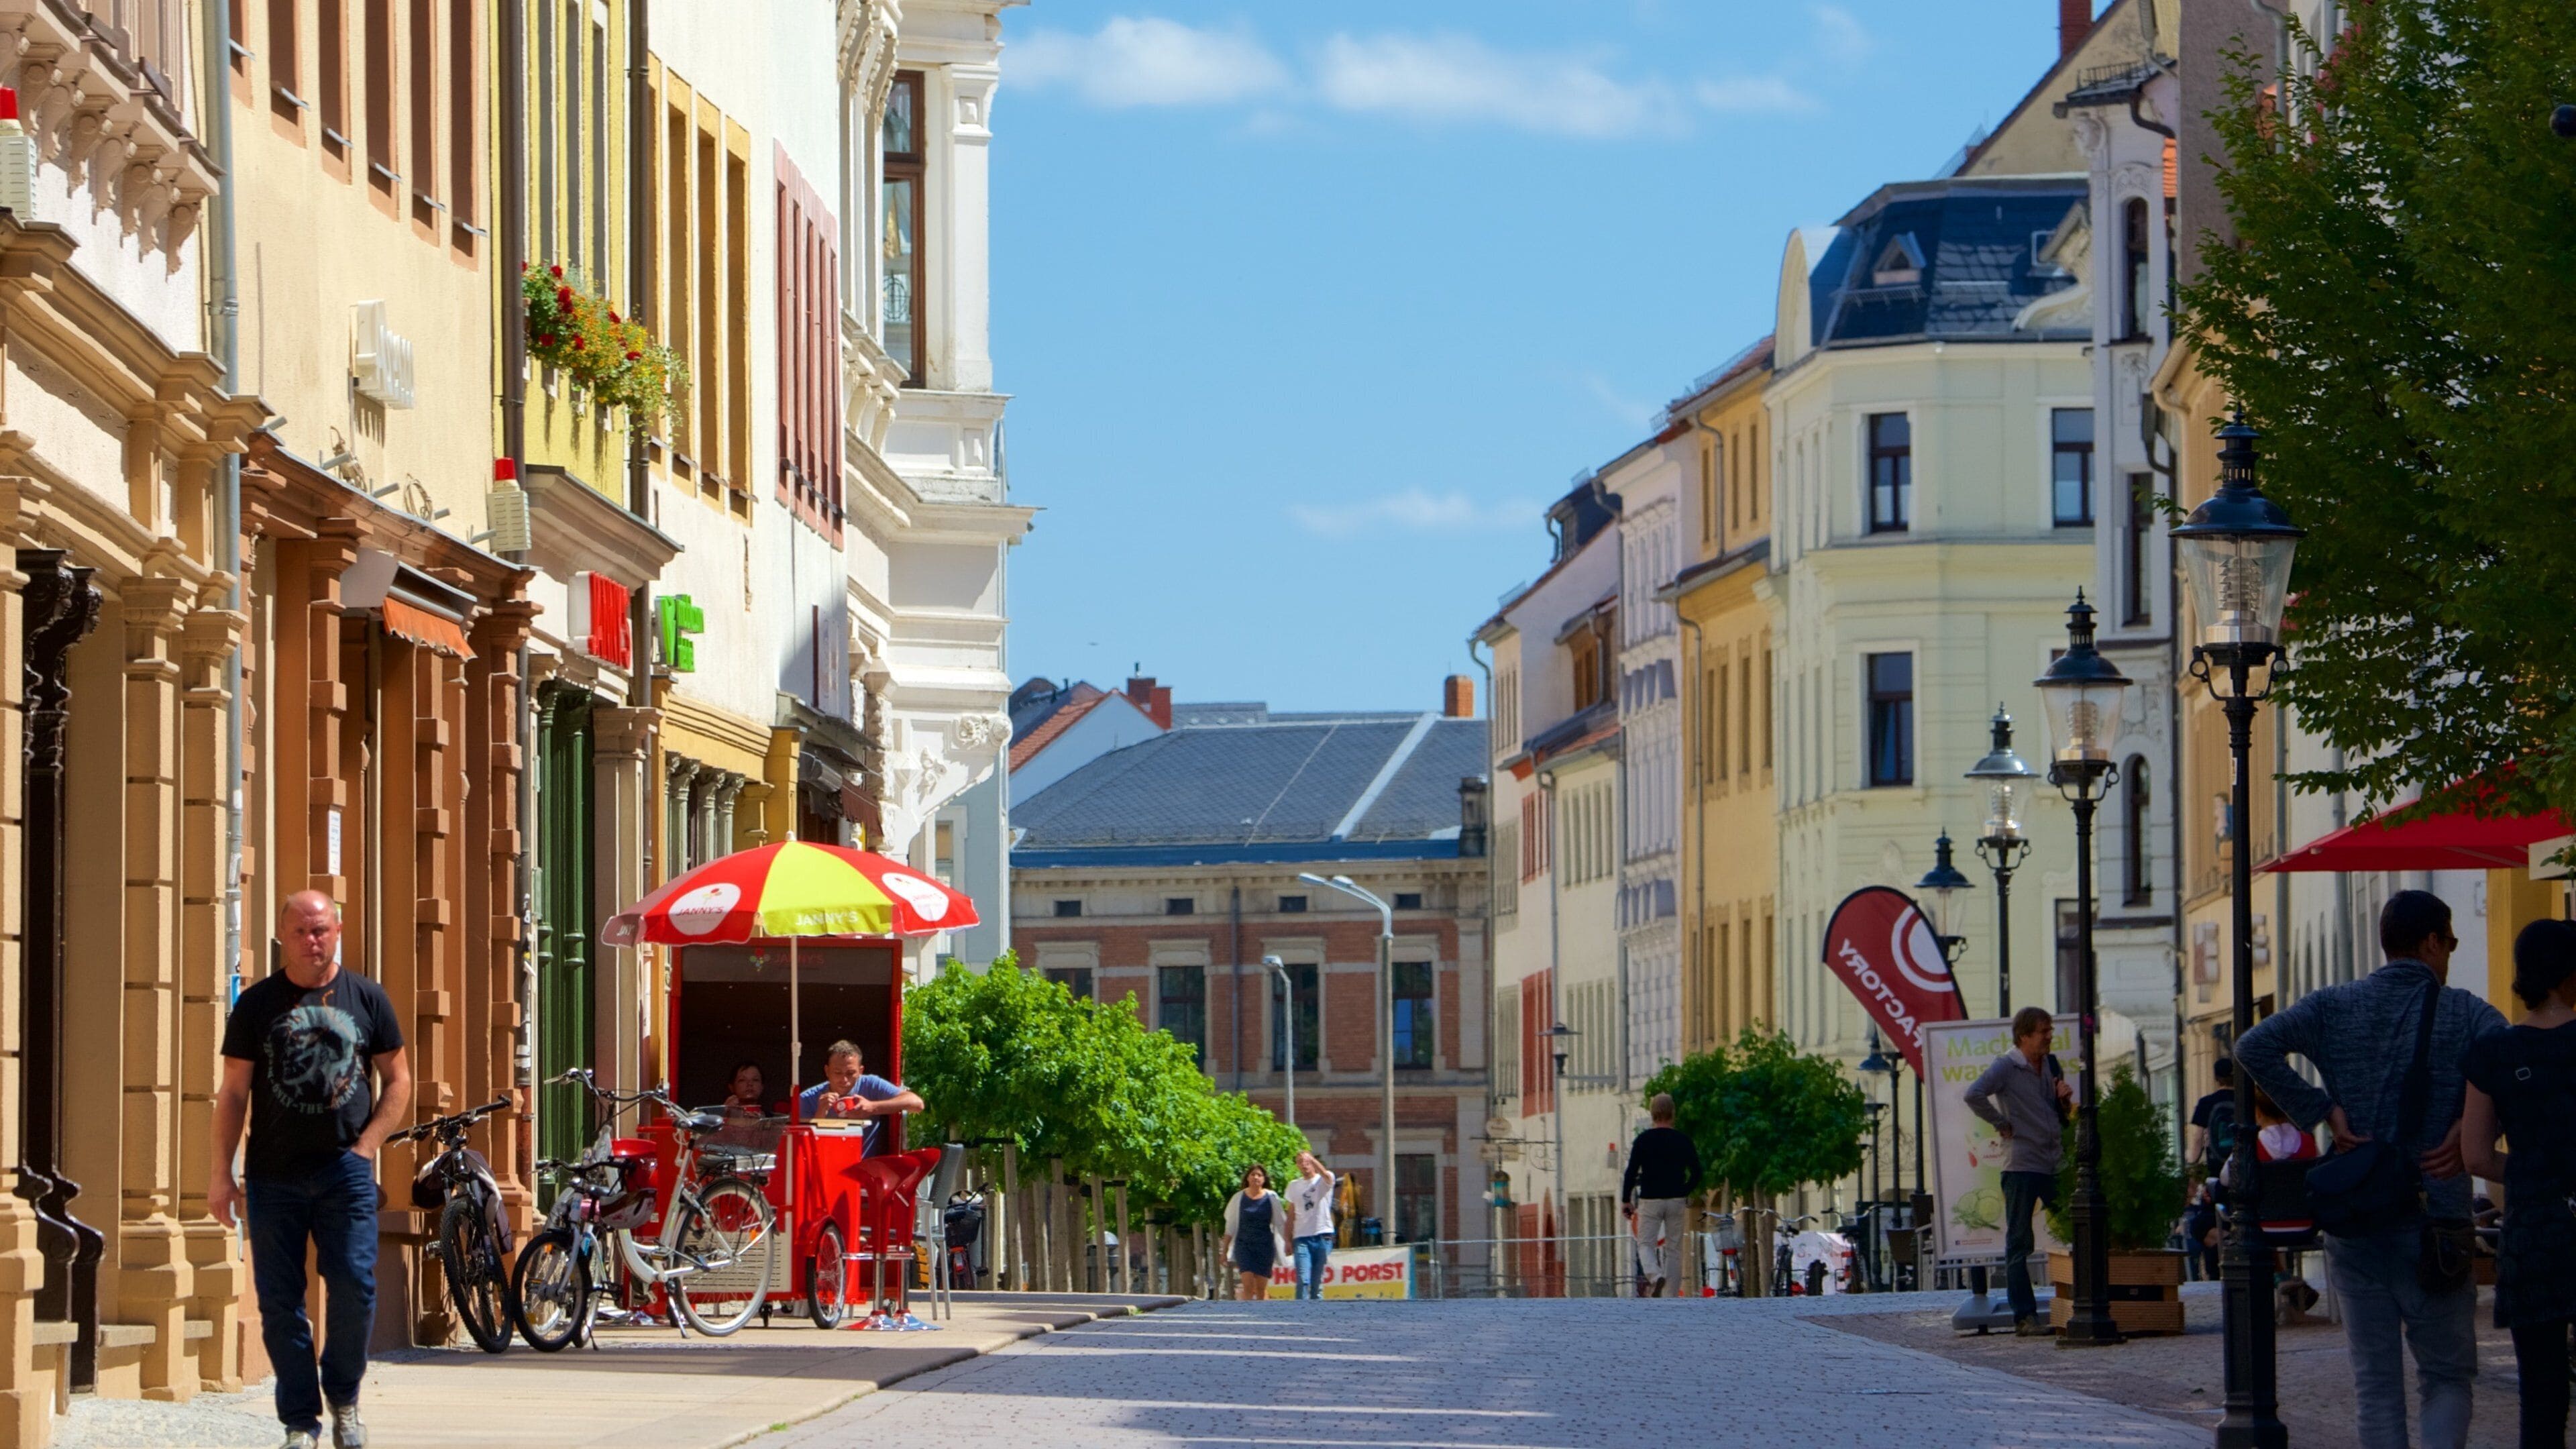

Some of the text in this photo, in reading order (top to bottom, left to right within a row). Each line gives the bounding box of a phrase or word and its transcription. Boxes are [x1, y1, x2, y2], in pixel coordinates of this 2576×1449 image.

[676, 906, 724, 916] JANNY'S
[796, 910, 858, 926] JANNY'S
[774, 953, 824, 964] JANY'S
[2050, 1027, 2071, 1051] al
[1272, 1262, 1404, 1285] HOO PORST
